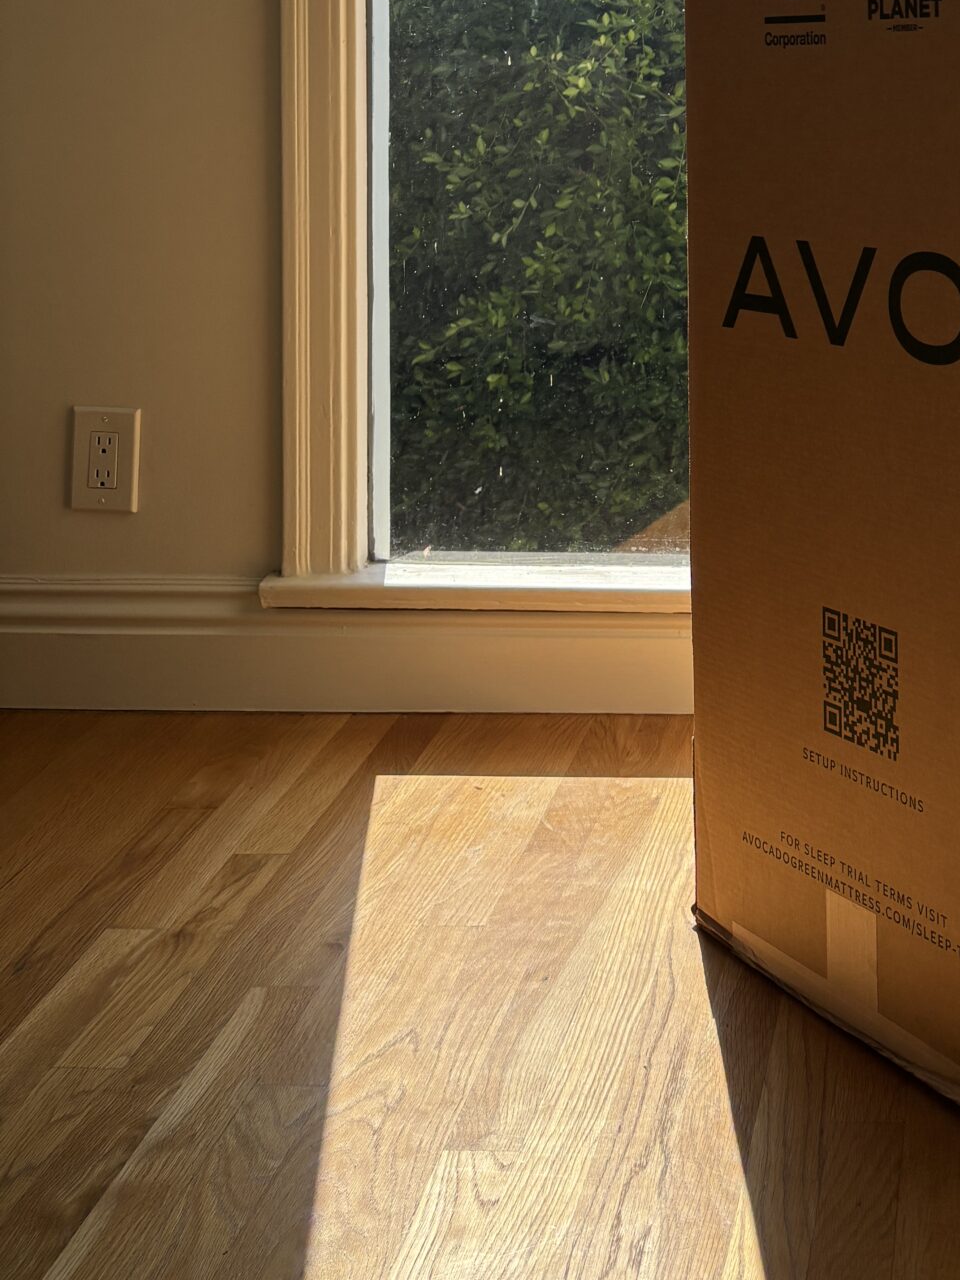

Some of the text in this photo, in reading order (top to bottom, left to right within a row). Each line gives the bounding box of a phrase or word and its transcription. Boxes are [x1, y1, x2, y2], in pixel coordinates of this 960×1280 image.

[765, 31, 826, 48] Corporation
[802, 747, 925, 813] SETUP INSTRUCTIONS
[780, 831, 948, 929] FOR SLEEP TRIAL TERMS VISIT
